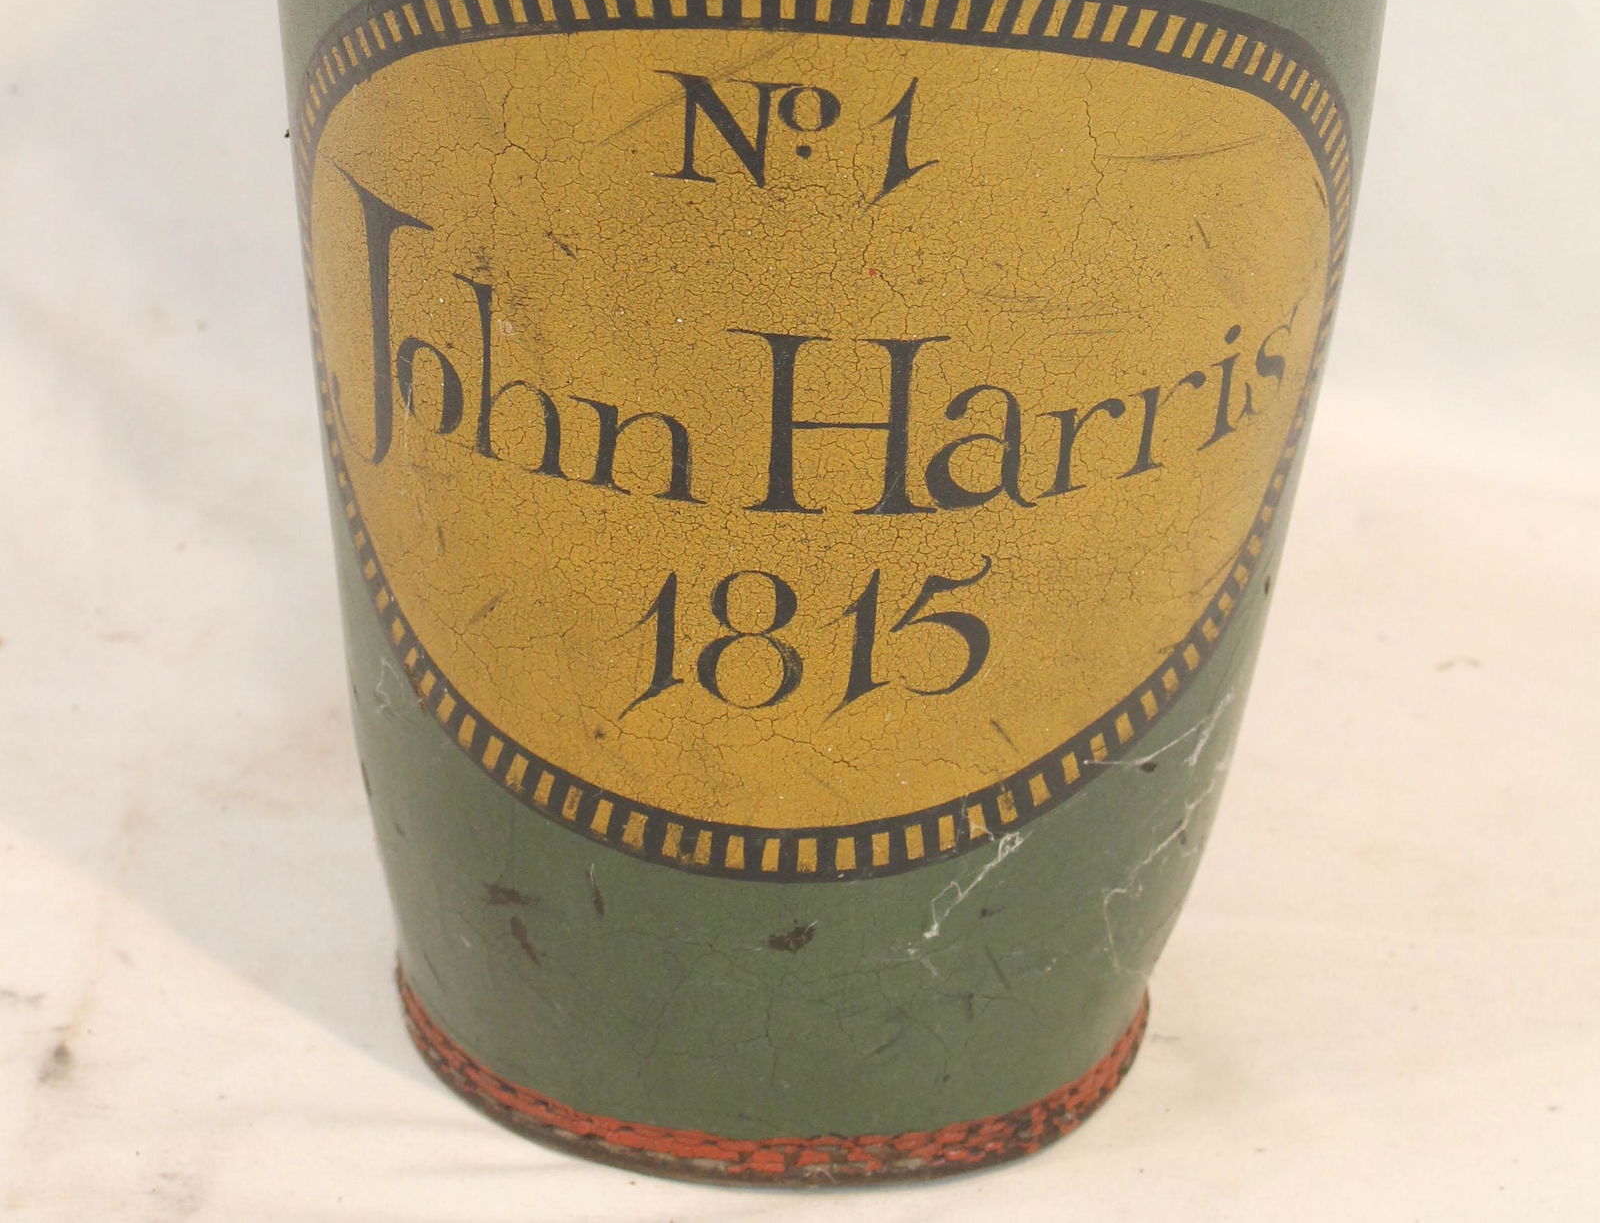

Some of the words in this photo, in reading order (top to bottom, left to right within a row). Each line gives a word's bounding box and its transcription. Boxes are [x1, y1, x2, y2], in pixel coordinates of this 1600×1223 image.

[862, 76, 940, 213] 1
[331, 161, 708, 505] John
[727, 307, 1298, 515] Harris
[616, 555, 993, 720] 1815
